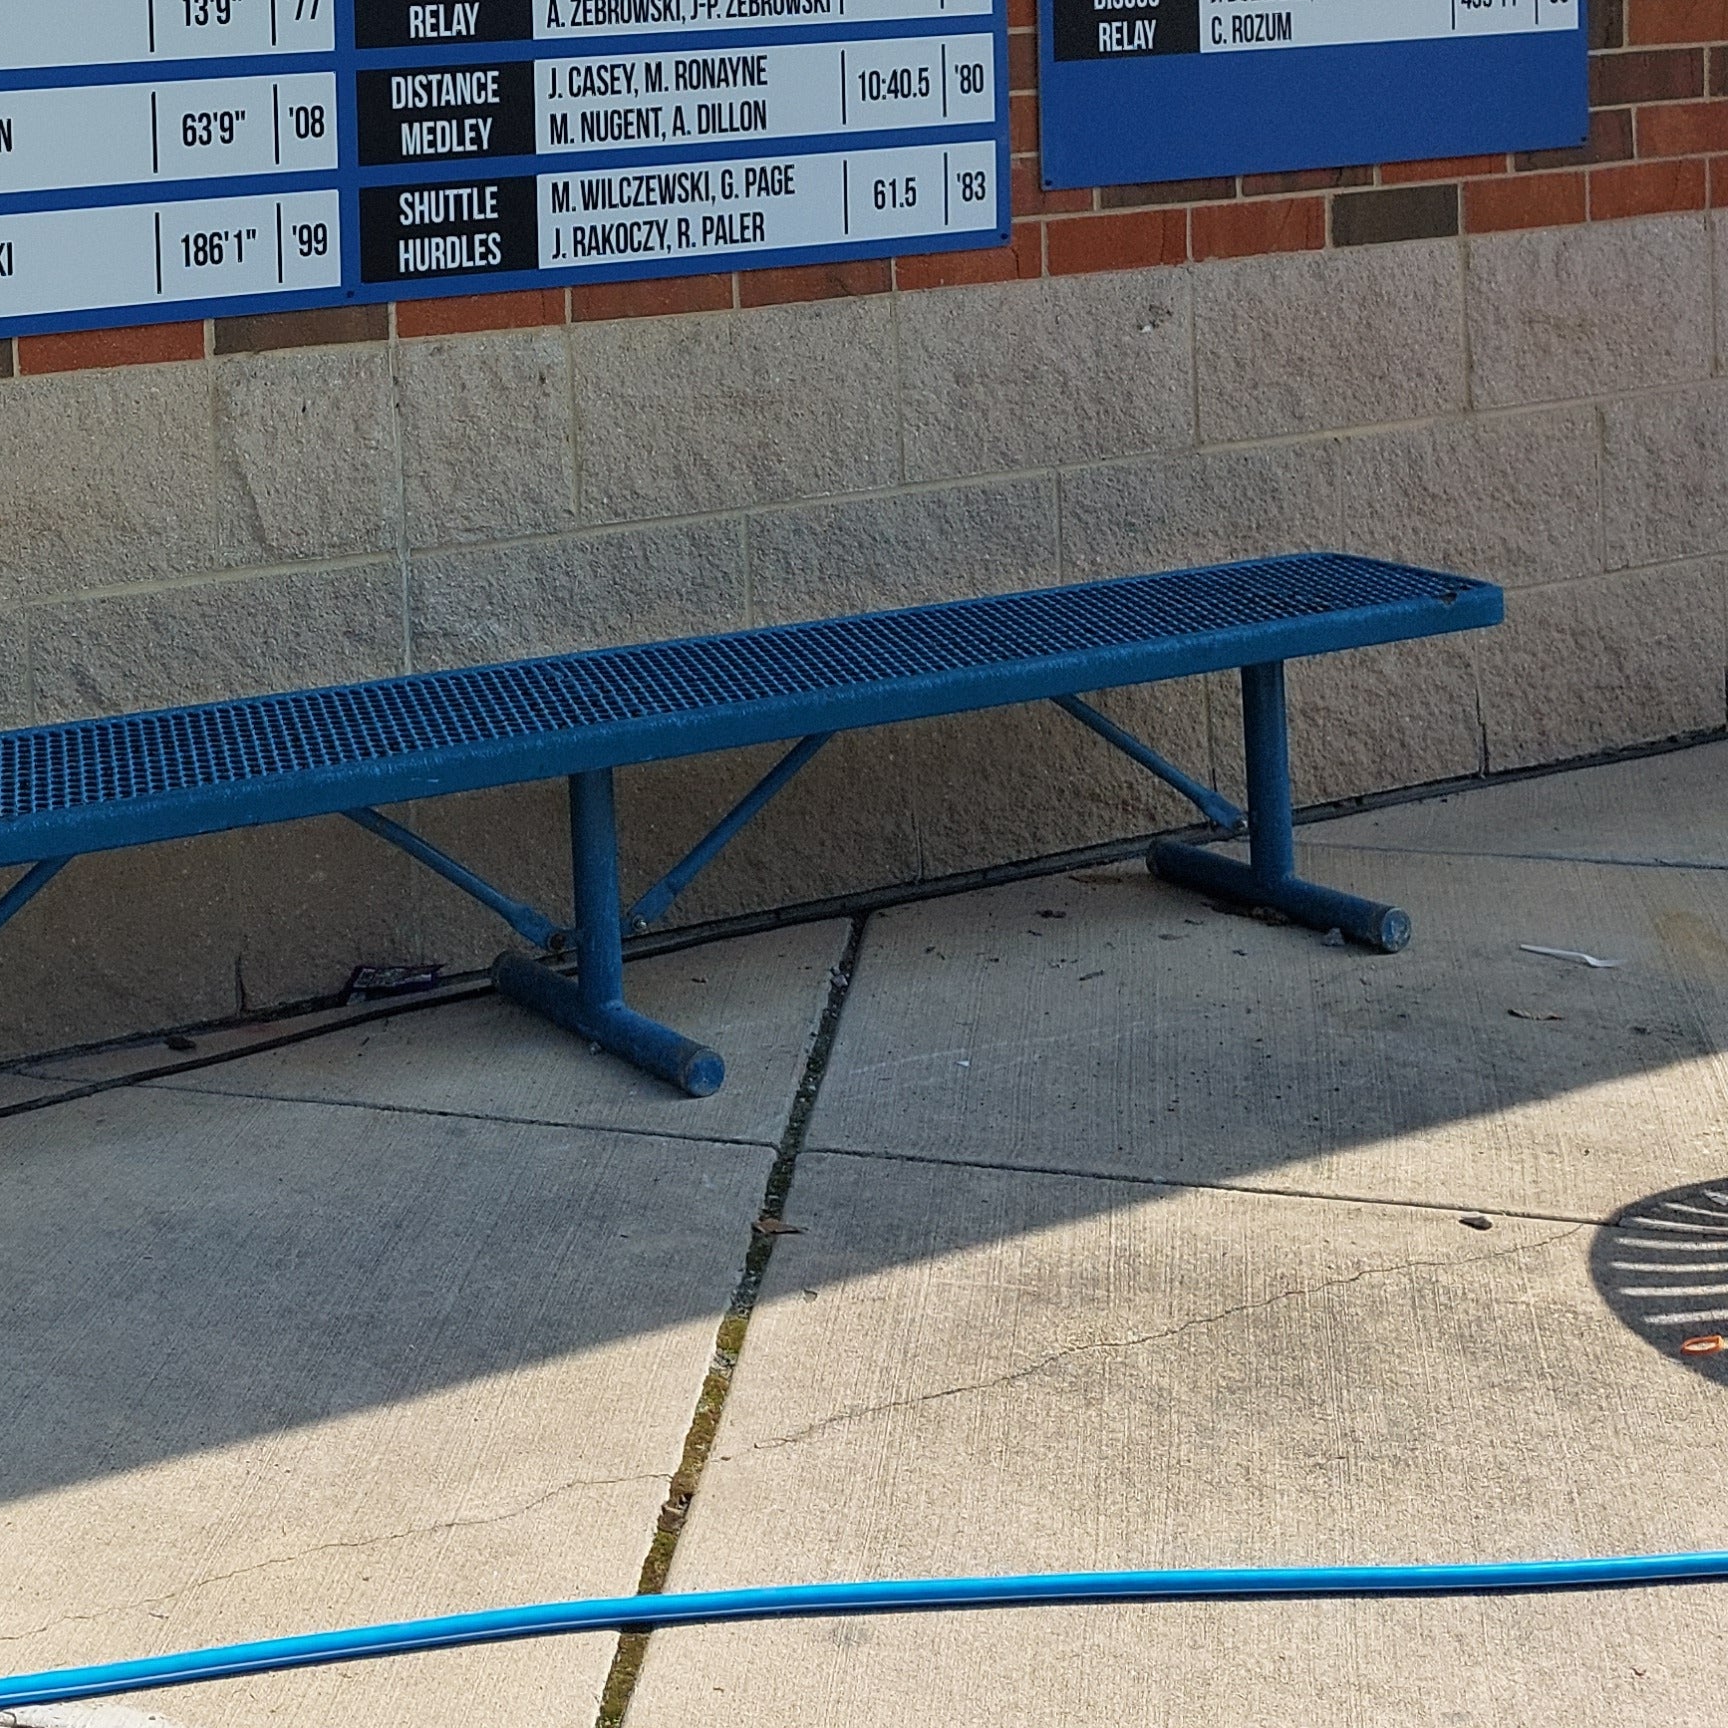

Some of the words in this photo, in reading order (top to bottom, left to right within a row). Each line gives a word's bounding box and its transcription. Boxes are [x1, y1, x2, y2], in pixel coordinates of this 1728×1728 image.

[409, 2, 479, 38] RELAY
[547, 0, 565, 28] A.
[1211, 16, 1227, 45] C.
[1232, 12, 1292, 43] ROZUM
[1099, 20, 1156, 52] RELAY
[552, 181, 576, 213] M.
[580, 171, 716, 211] WILCZEWSKI,
[721, 169, 739, 200] G.
[745, 164, 795, 198] PAGE
[874, 177, 916, 210] 61.5
[957, 171, 986, 202] '83
[399, 186, 498, 225] SHUTTLE
[181, 229, 256, 267] 186'1"
[292, 223, 327, 257] '99
[399, 232, 501, 272] HURDLES
[552, 228, 566, 259] J.
[573, 219, 671, 257] RAKOCZY,
[677, 218, 696, 249] R.
[702, 212, 765, 246] PALER
